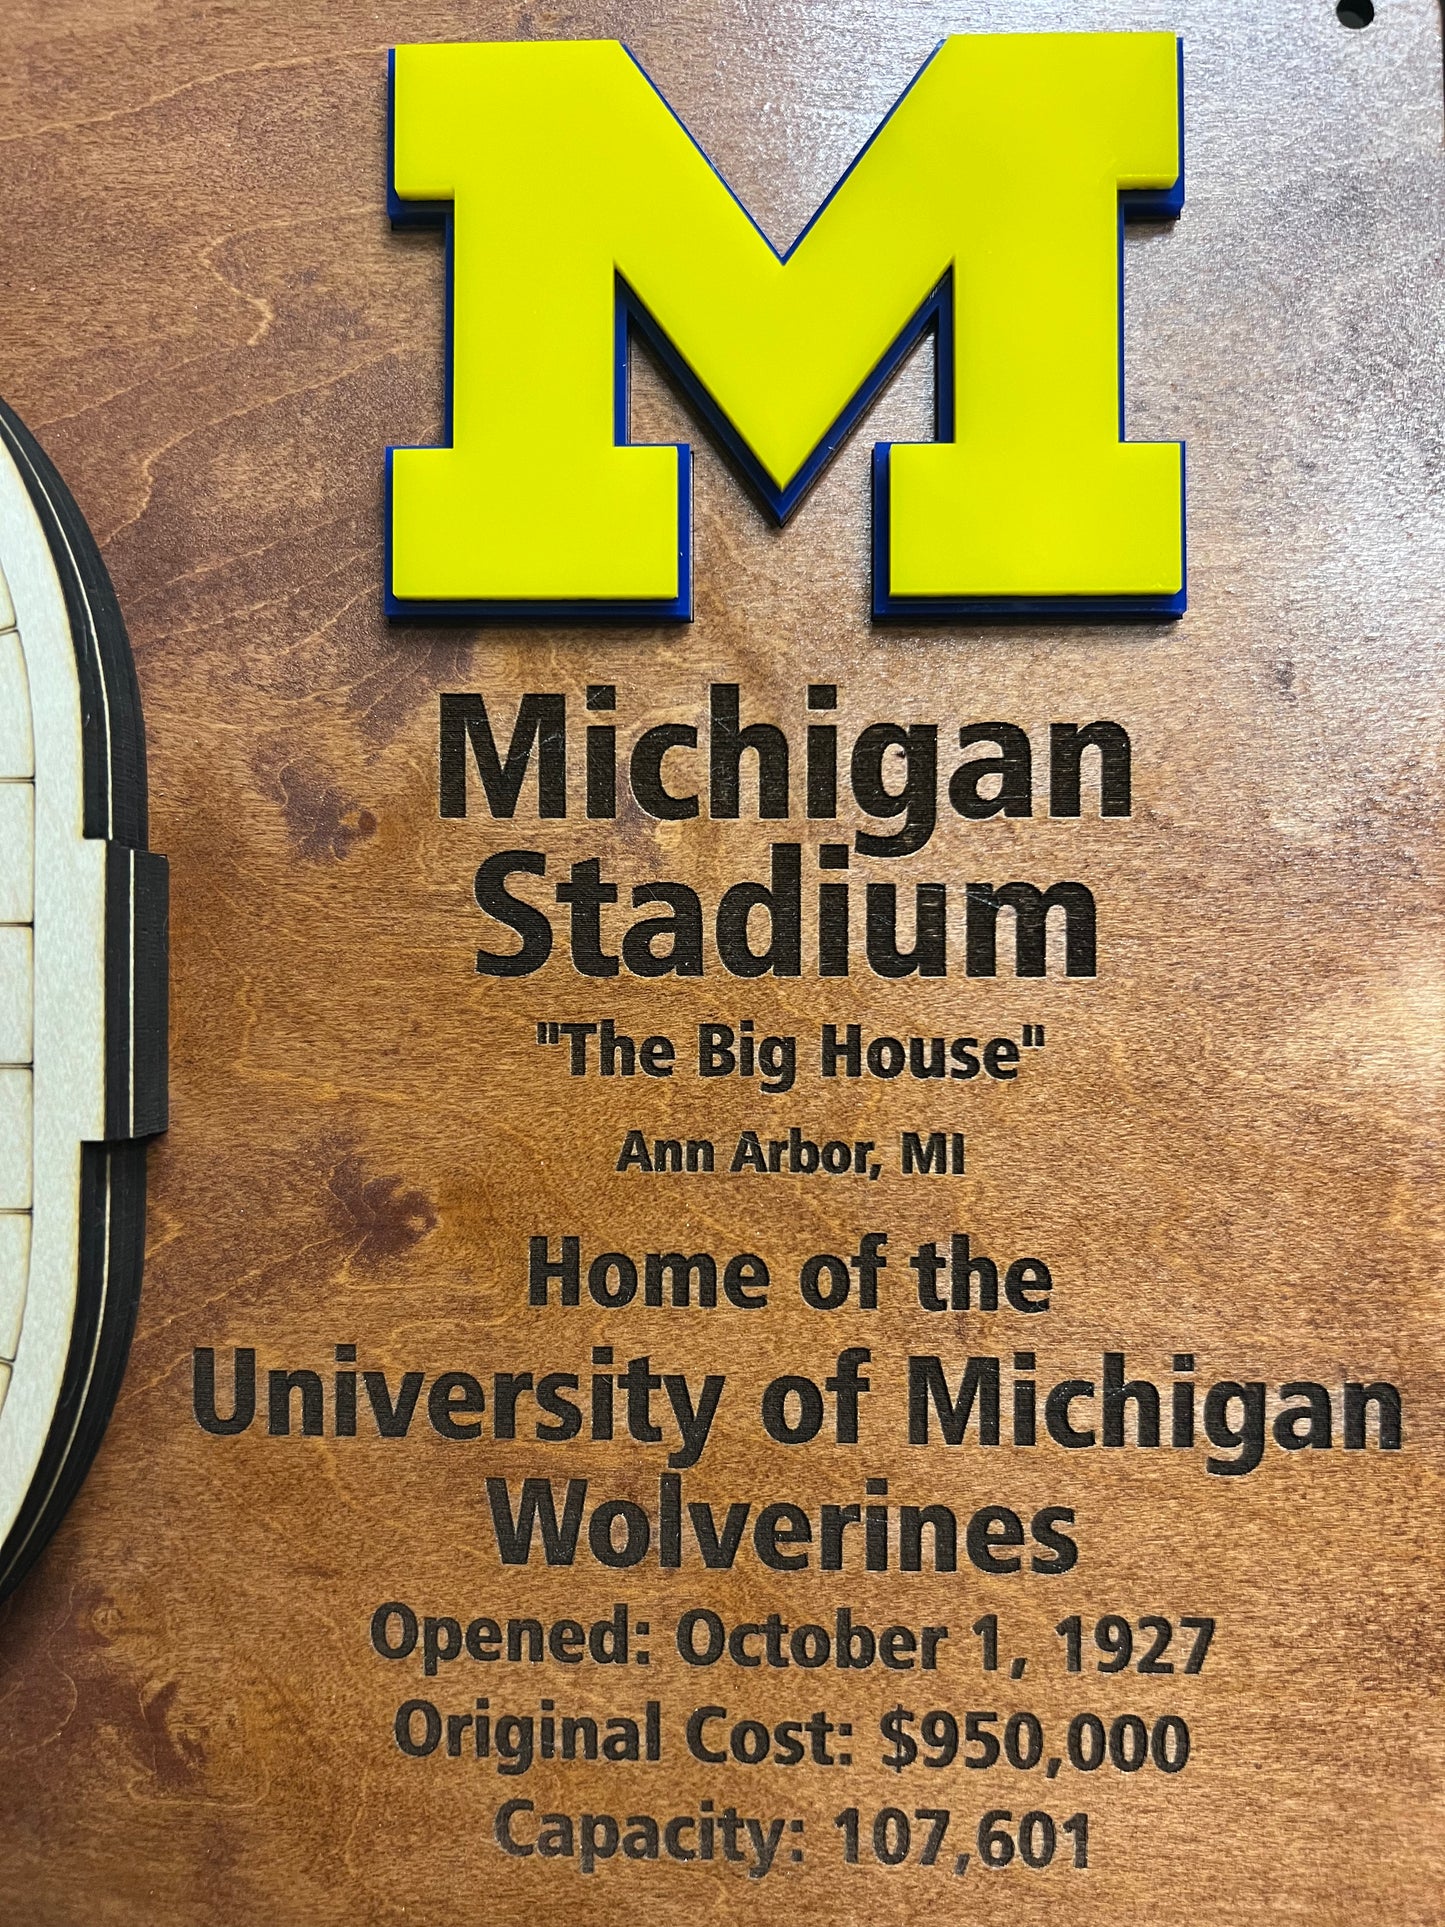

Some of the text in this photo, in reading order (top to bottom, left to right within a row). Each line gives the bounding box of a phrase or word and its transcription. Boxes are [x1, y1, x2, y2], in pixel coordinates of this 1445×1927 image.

[386, 32, 1185, 620] M
[440, 683, 1131, 857] Michigan
[475, 843, 1096, 978] Stadium
[537, 1019, 1045, 1093] "The Big House"
[616, 1127, 964, 1180] Ann Arbor, MI
[529, 1231, 1052, 1312] Home of the
[193, 1342, 1403, 1475] University of Michigan
[486, 1471, 1078, 1574] Wolverines
[371, 1602, 1216, 1680] Opened: October 1, 1927
[393, 1698, 1191, 1778] Original Cost: $950,000
[495, 1799, 1089, 1878] Capacity: 107,601
